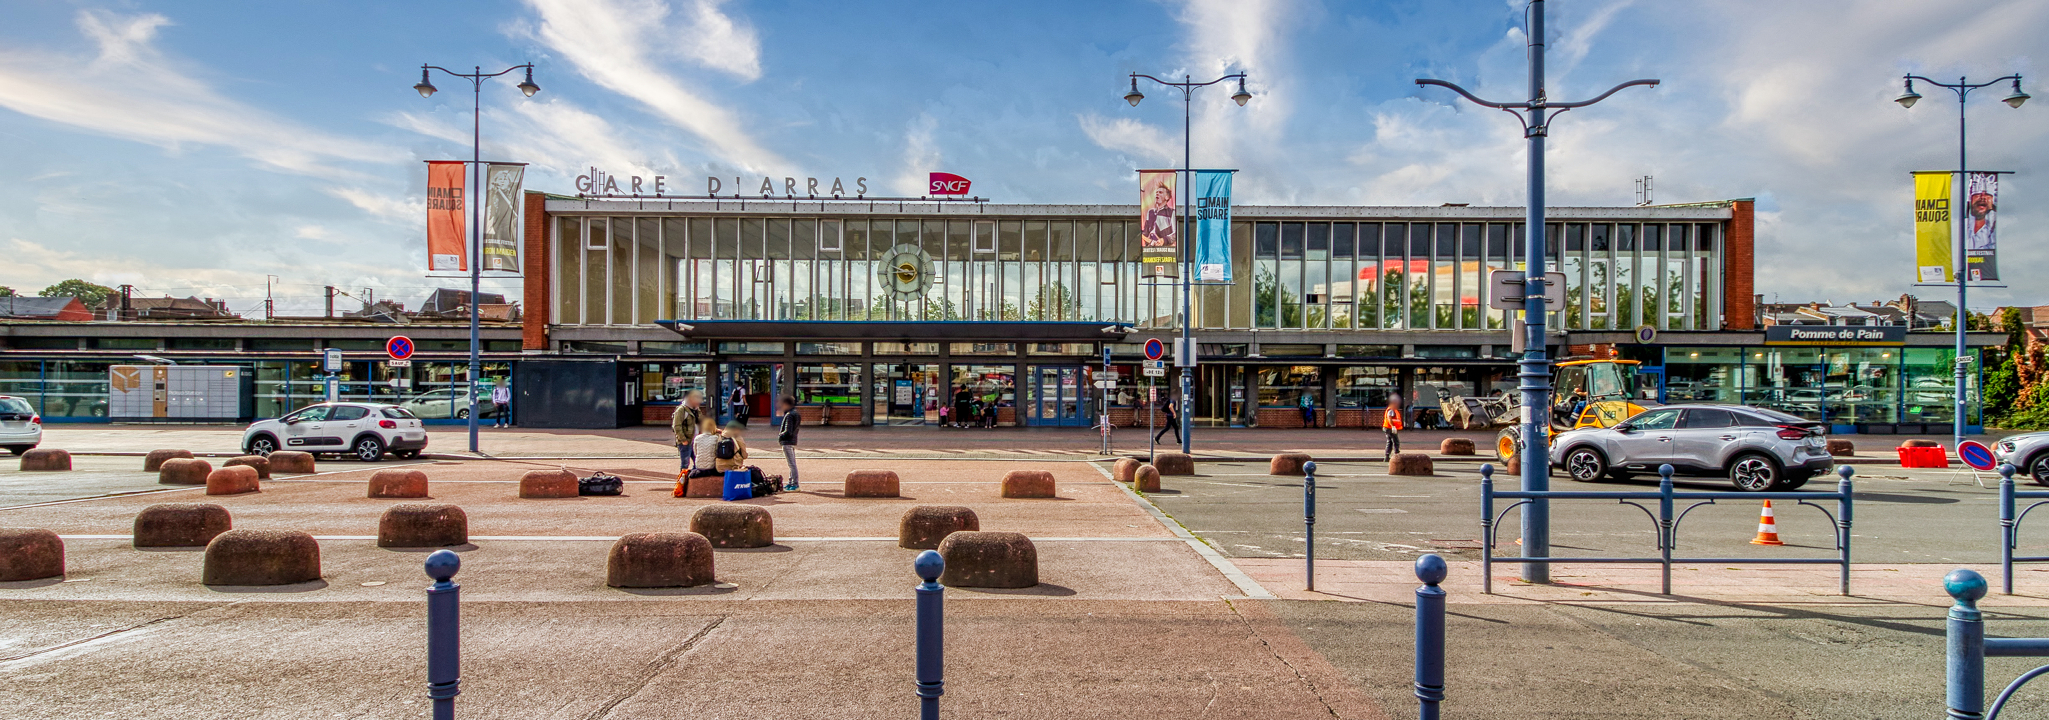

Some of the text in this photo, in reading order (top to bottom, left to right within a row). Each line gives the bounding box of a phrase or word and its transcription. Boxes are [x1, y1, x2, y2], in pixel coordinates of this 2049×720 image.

[575, 174, 665, 193] GARE
[930, 180, 969, 192] SNCF
[1208, 197, 1229, 208] MAIN
[1197, 208, 1228, 220] SQUARE
[1790, 329, 1884, 339] Pomme de Pain
